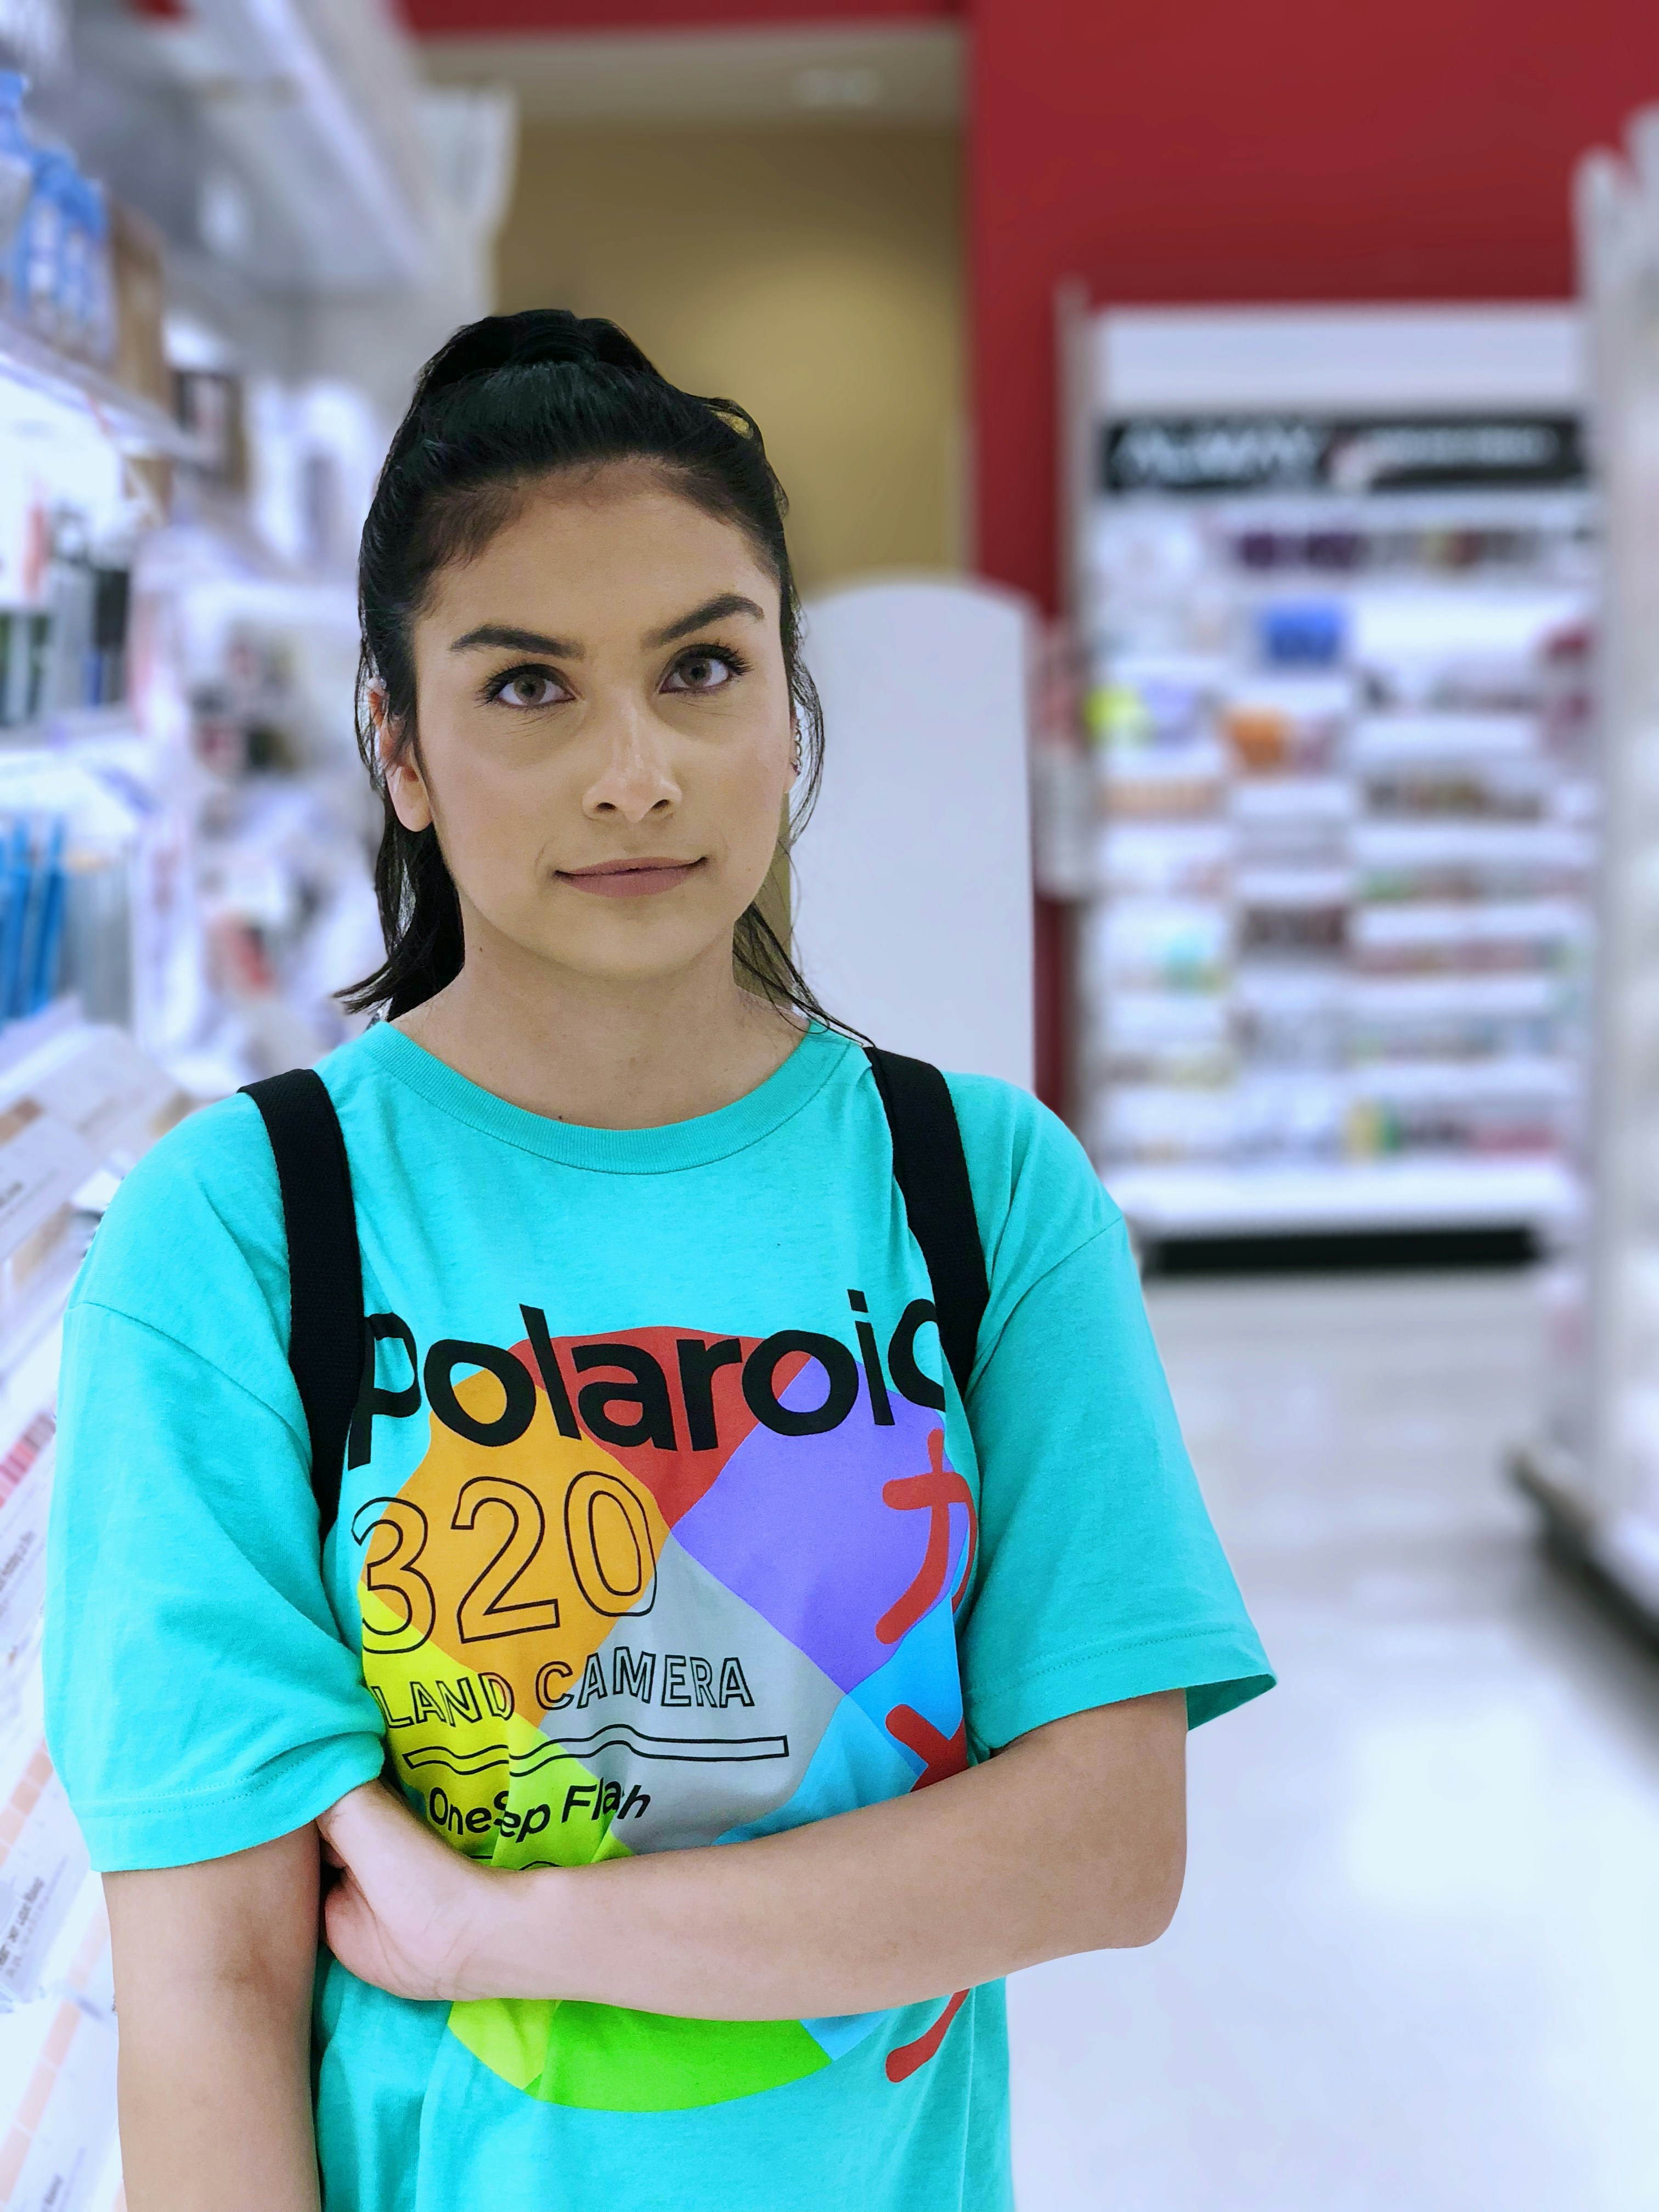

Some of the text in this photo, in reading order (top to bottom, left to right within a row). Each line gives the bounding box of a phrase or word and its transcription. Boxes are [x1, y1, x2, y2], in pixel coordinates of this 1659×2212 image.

[351, 1470, 658, 1654] 320
[371, 1646, 754, 1728] LAND CAMERA
